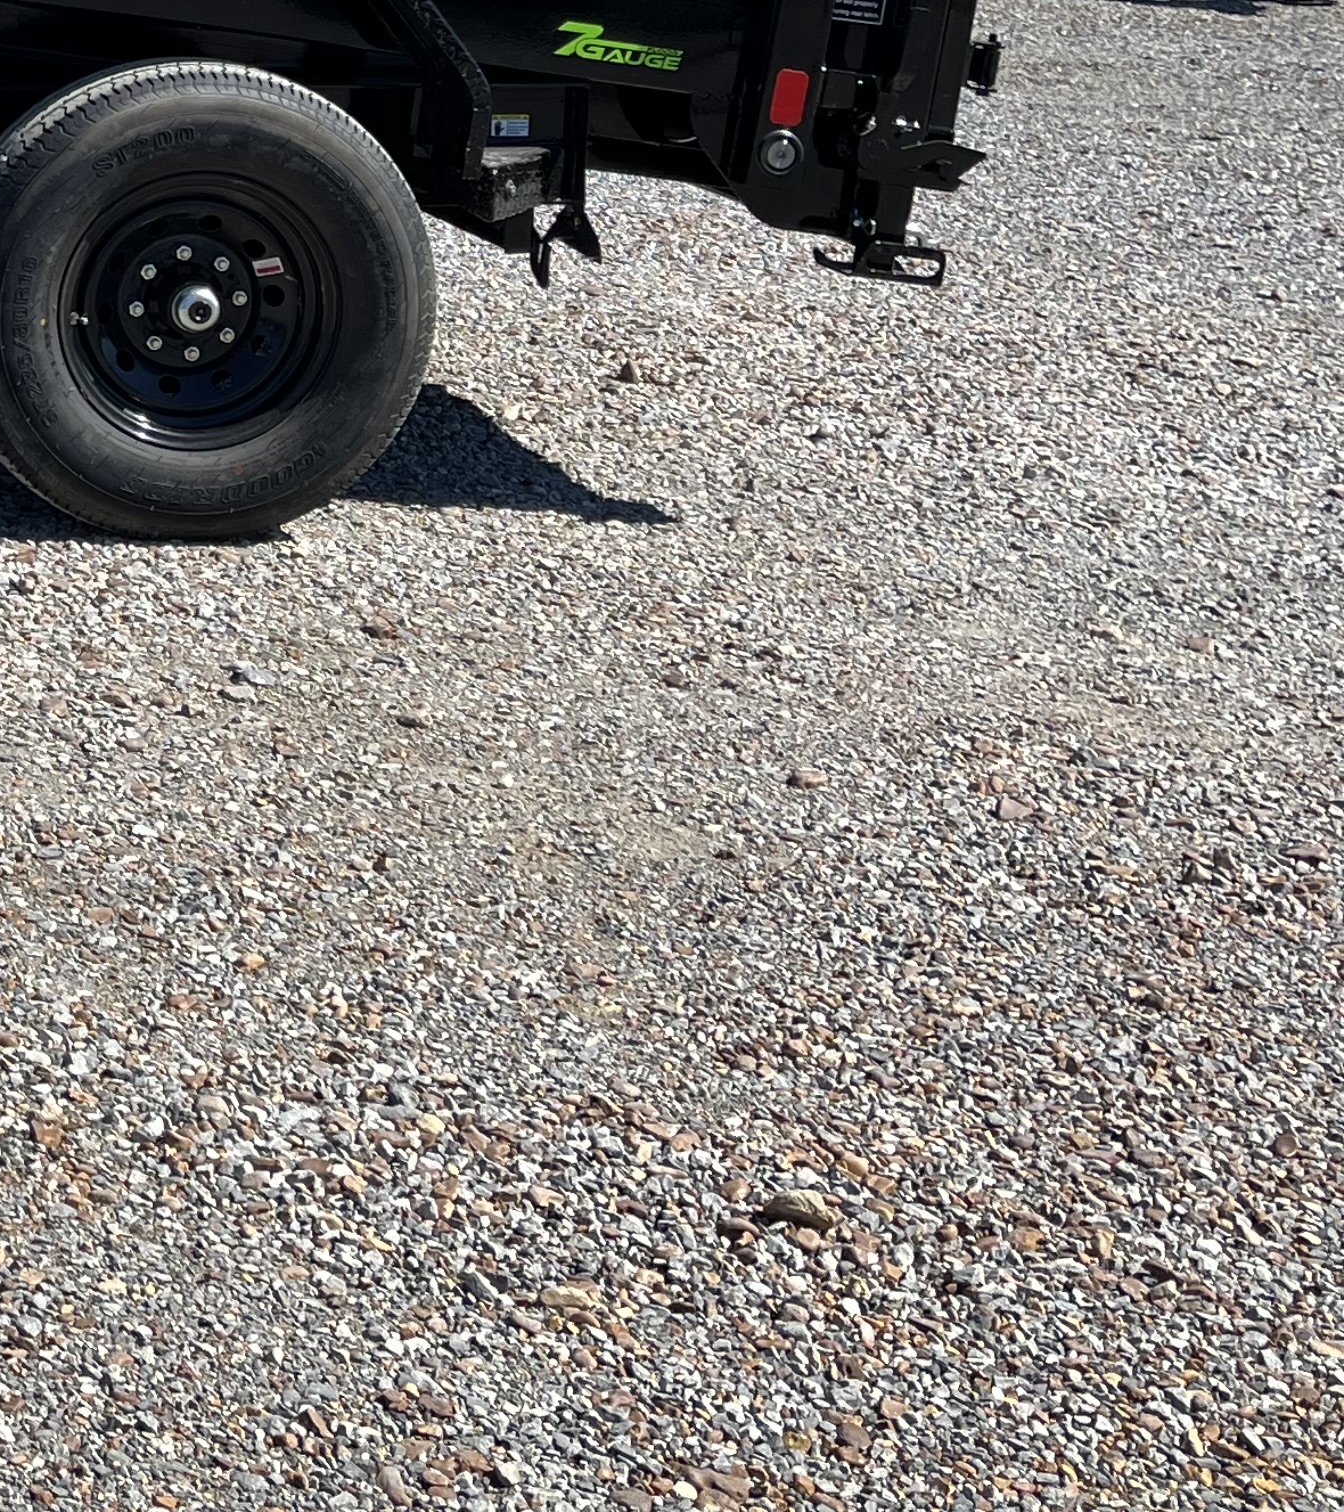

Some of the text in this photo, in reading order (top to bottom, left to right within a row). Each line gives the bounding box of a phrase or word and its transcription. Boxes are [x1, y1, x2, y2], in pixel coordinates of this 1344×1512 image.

[553, 21, 682, 71] 7 GAUGE
[92, 126, 197, 179] ST200
